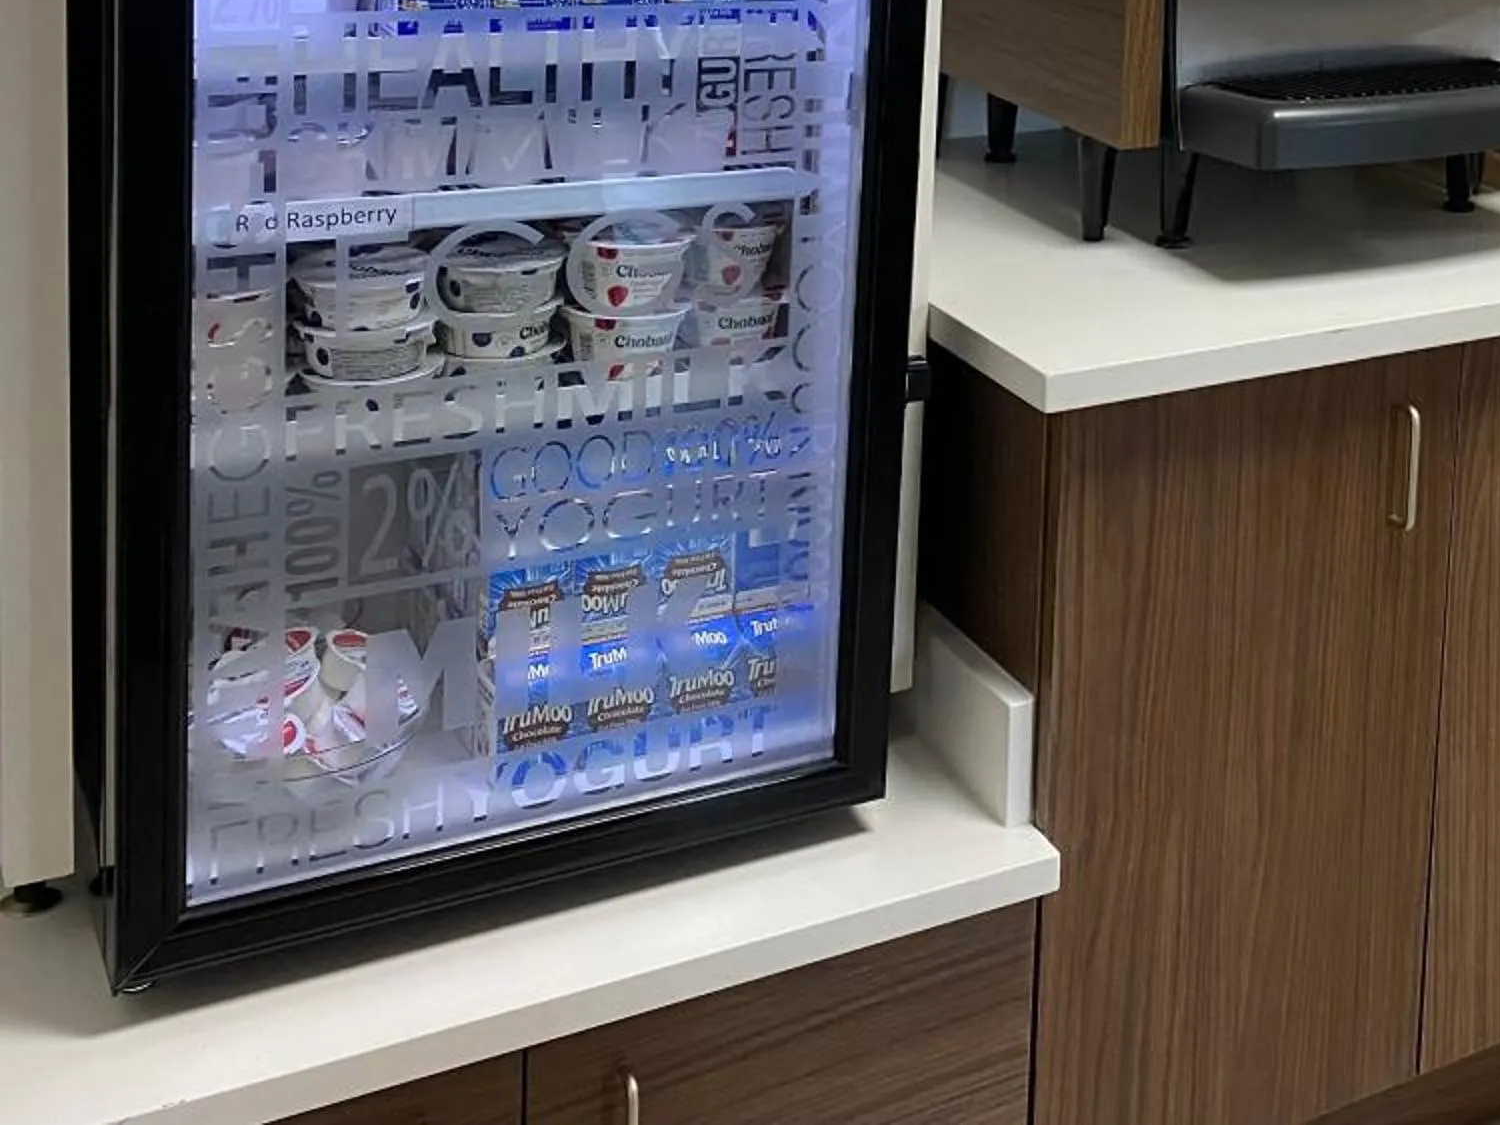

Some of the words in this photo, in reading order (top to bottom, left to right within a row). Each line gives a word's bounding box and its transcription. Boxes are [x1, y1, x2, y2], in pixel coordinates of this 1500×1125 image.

[292, 16, 697, 116] HEALTHY
[234, 213, 278, 233] Rd
[286, 206, 398, 232] Raspberry
[555, 345, 789, 430] MILK
[284, 469, 343, 603] 100%
[359, 452, 476, 574] 2%
